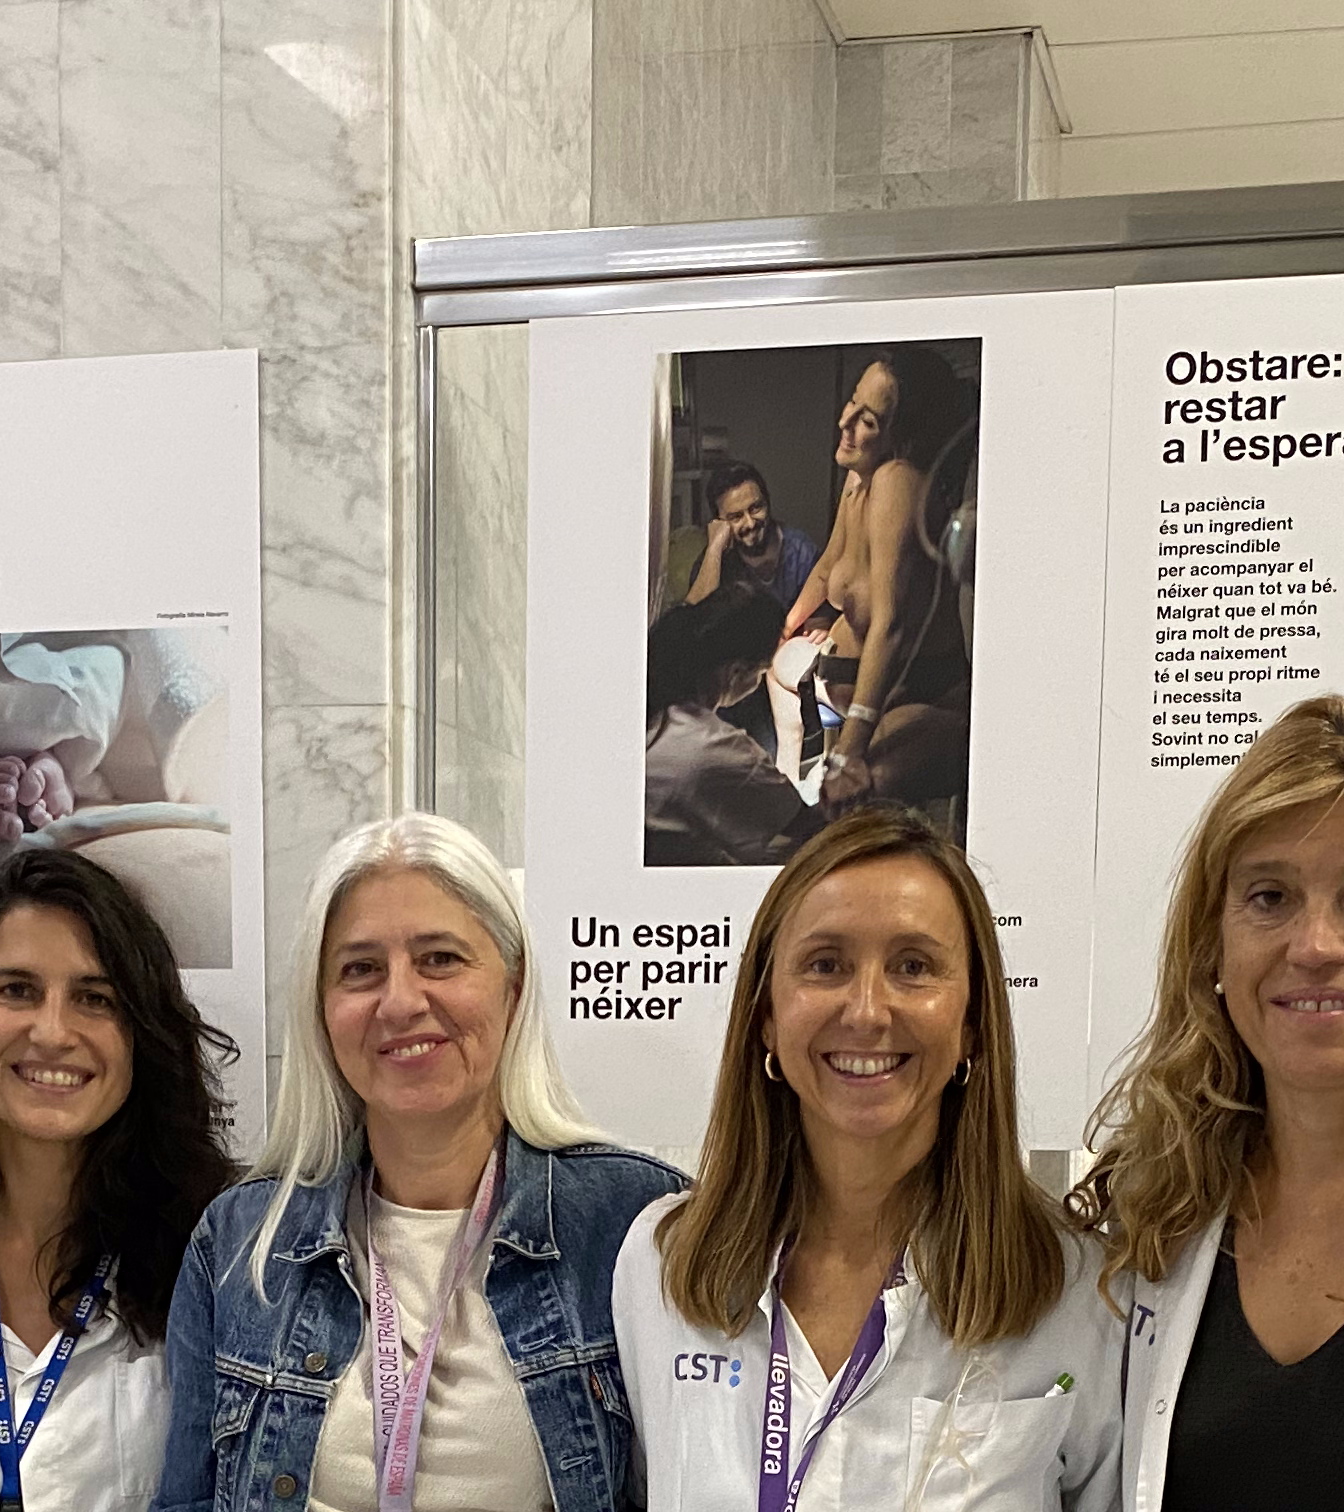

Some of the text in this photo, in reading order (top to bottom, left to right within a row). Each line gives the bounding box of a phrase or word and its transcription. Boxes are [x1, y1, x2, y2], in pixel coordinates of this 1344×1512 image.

[1166, 350, 1342, 385] Obstare:
[1165, 391, 1286, 424] restar
[1163, 439, 1184, 463] a
[1161, 496, 1265, 516] La paciència
[1159, 517, 1293, 536] és un ingredient
[1159, 538, 1280, 558] imprescindible
[1158, 558, 1313, 581] per acompanyar el
[1157, 578, 1337, 599] néixer quan tot va bé.
[1157, 600, 1317, 622] Malgrat que el món
[1156, 625, 1320, 644] gira molt de pressa,
[1155, 645, 1287, 662] cada naixement
[1154, 665, 1320, 684] té el seu propi ritme
[1153, 689, 1241, 704] i necessita
[1153, 711, 1262, 726] el seu temps.
[1152, 732, 1203, 746] Sovint
[1208, 734, 1228, 744] no
[1151, 753, 1246, 769] simplemen
[572, 917, 730, 955] Un espai
[571, 953, 728, 991] per parir
[570, 987, 682, 1020] néixer
[379, 1347, 398, 1372] QUE
[764, 1353, 789, 1475] llevadora
